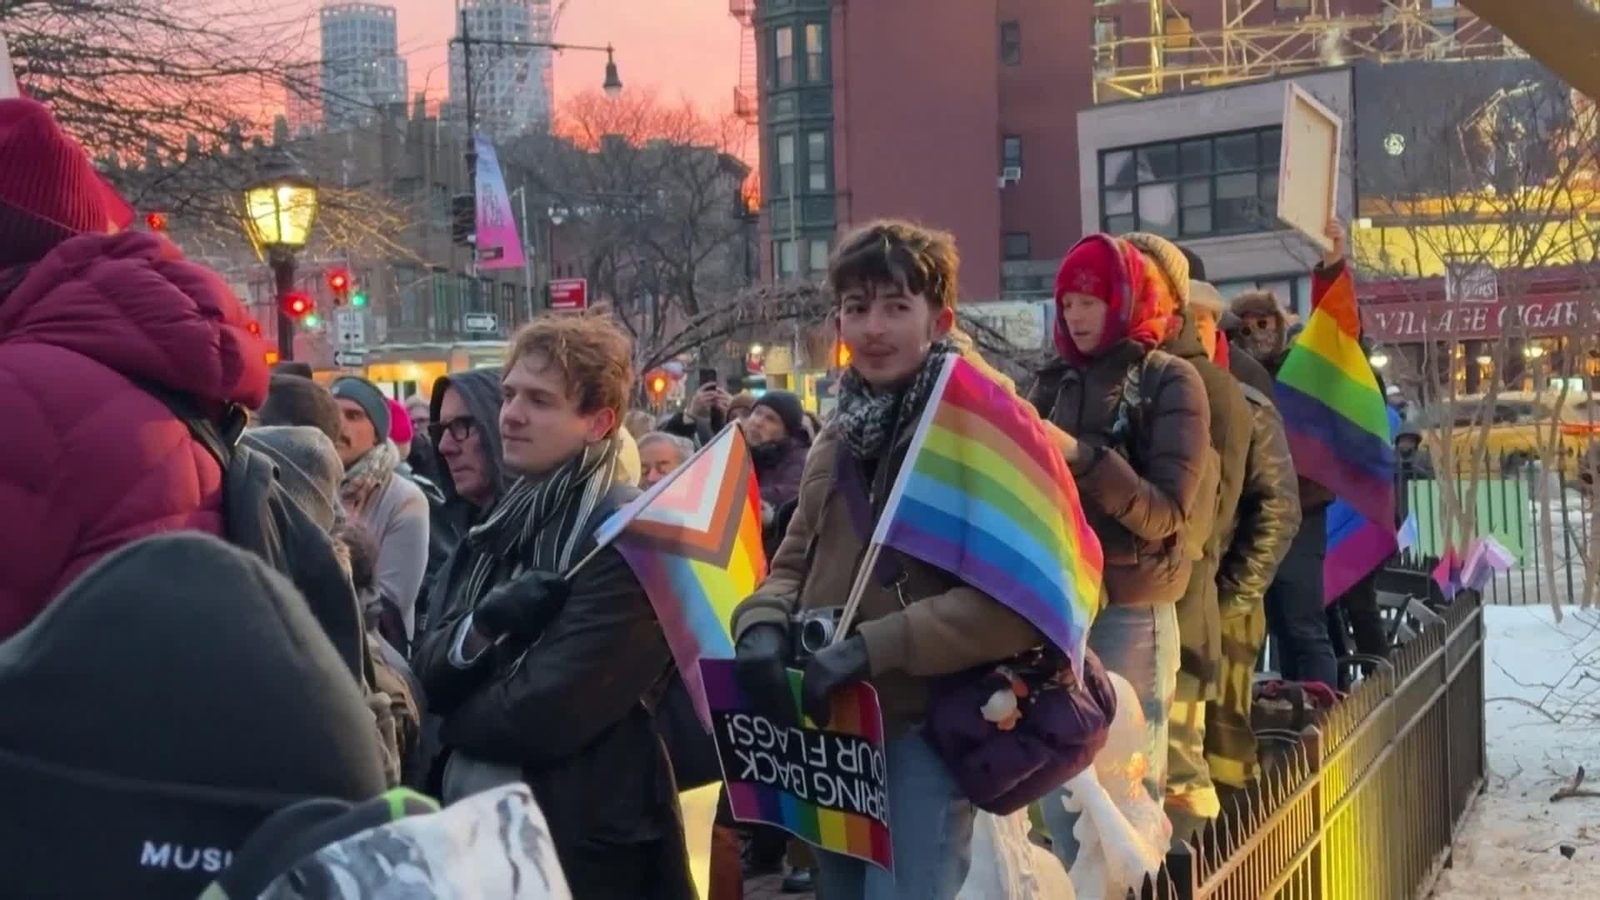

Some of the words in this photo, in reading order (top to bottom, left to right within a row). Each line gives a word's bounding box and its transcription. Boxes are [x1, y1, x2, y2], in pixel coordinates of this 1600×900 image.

[724, 713, 827, 768] FLAGS!
[835, 737, 884, 786] OUR
[734, 749, 808, 799] BACK
[813, 772, 887, 827] BRING
